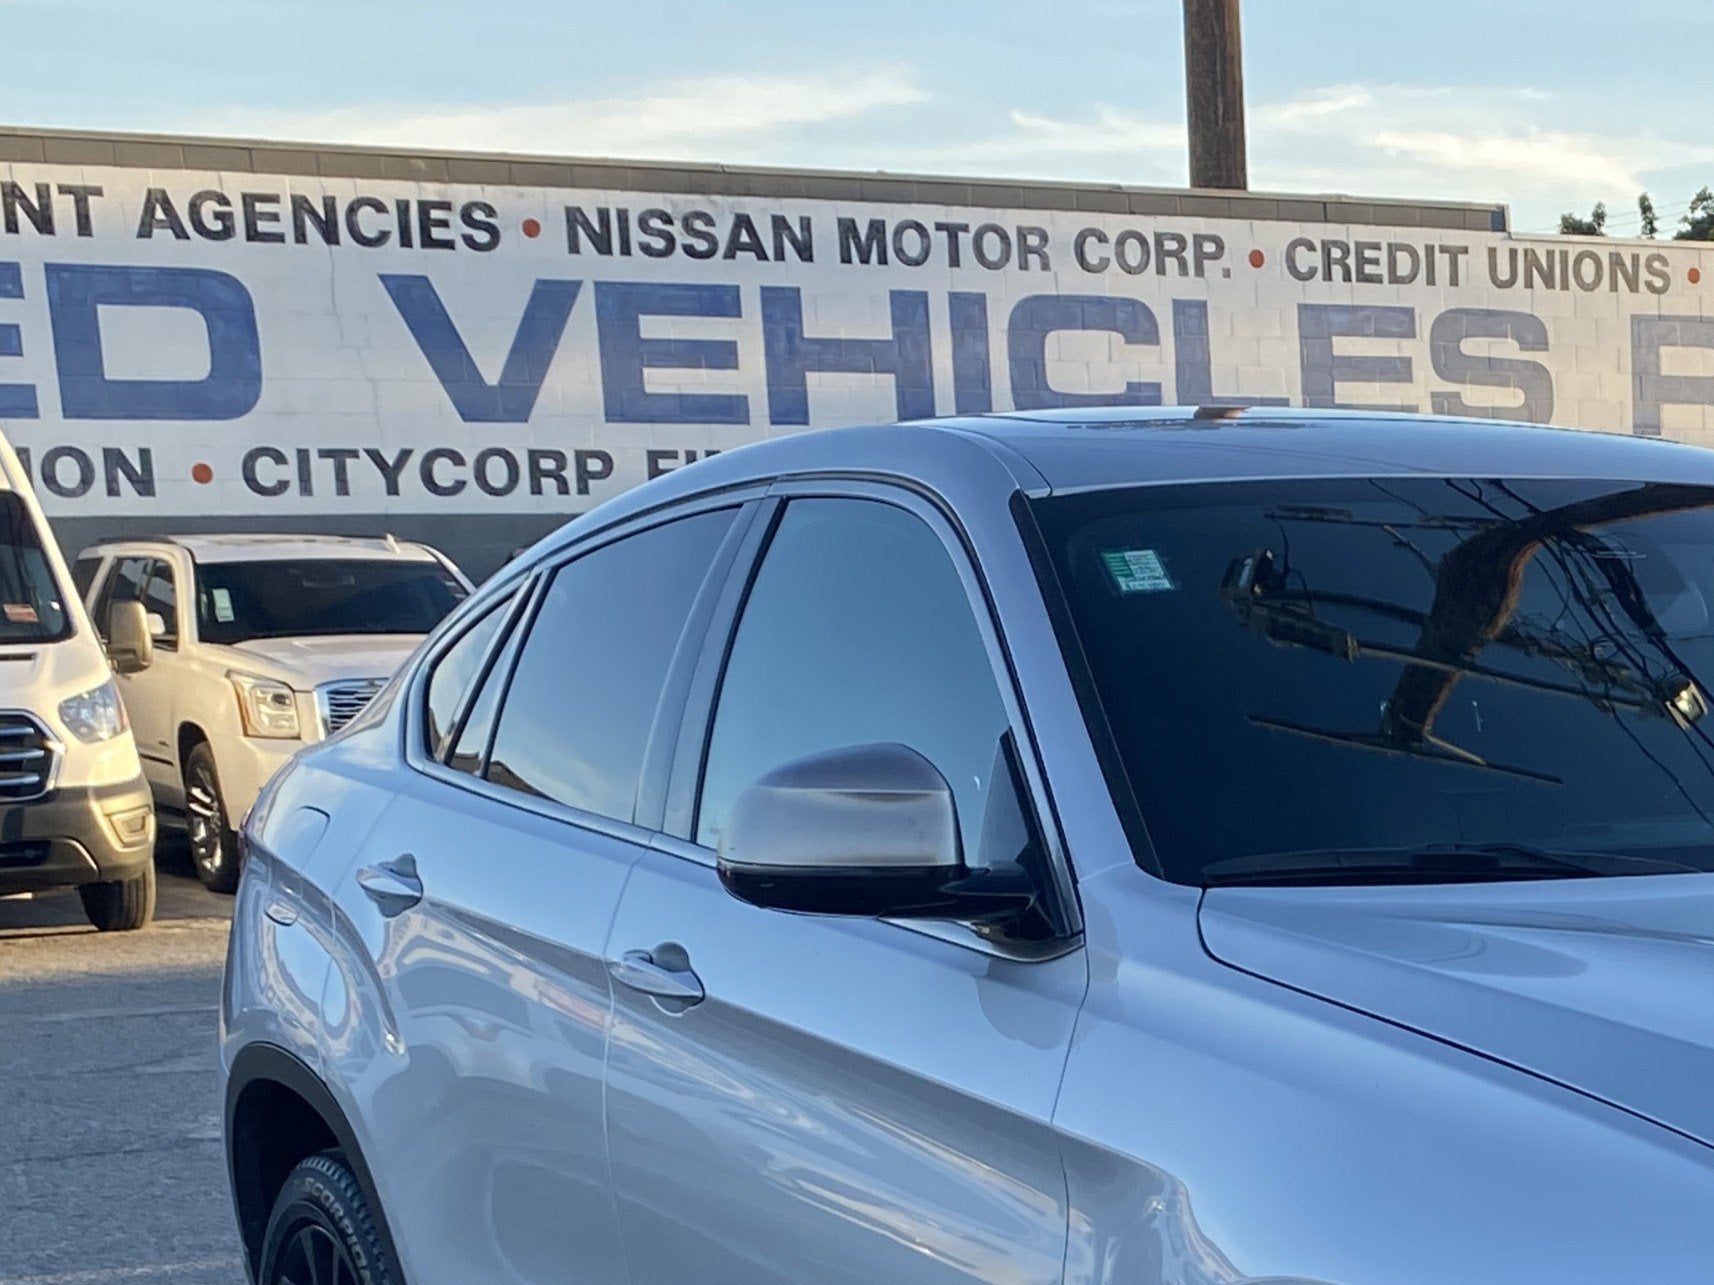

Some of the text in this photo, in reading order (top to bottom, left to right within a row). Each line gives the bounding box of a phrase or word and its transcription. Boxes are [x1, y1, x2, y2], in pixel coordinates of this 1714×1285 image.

[136, 187, 502, 252] AGENCIES
[565, 206, 1231, 279] NISSAN MOTOR CORP.
[1286, 237, 1671, 295] CREDIT UNIONS
[378, 273, 1554, 425] VEHICLES
[242, 446, 614, 498] CITYCORP
